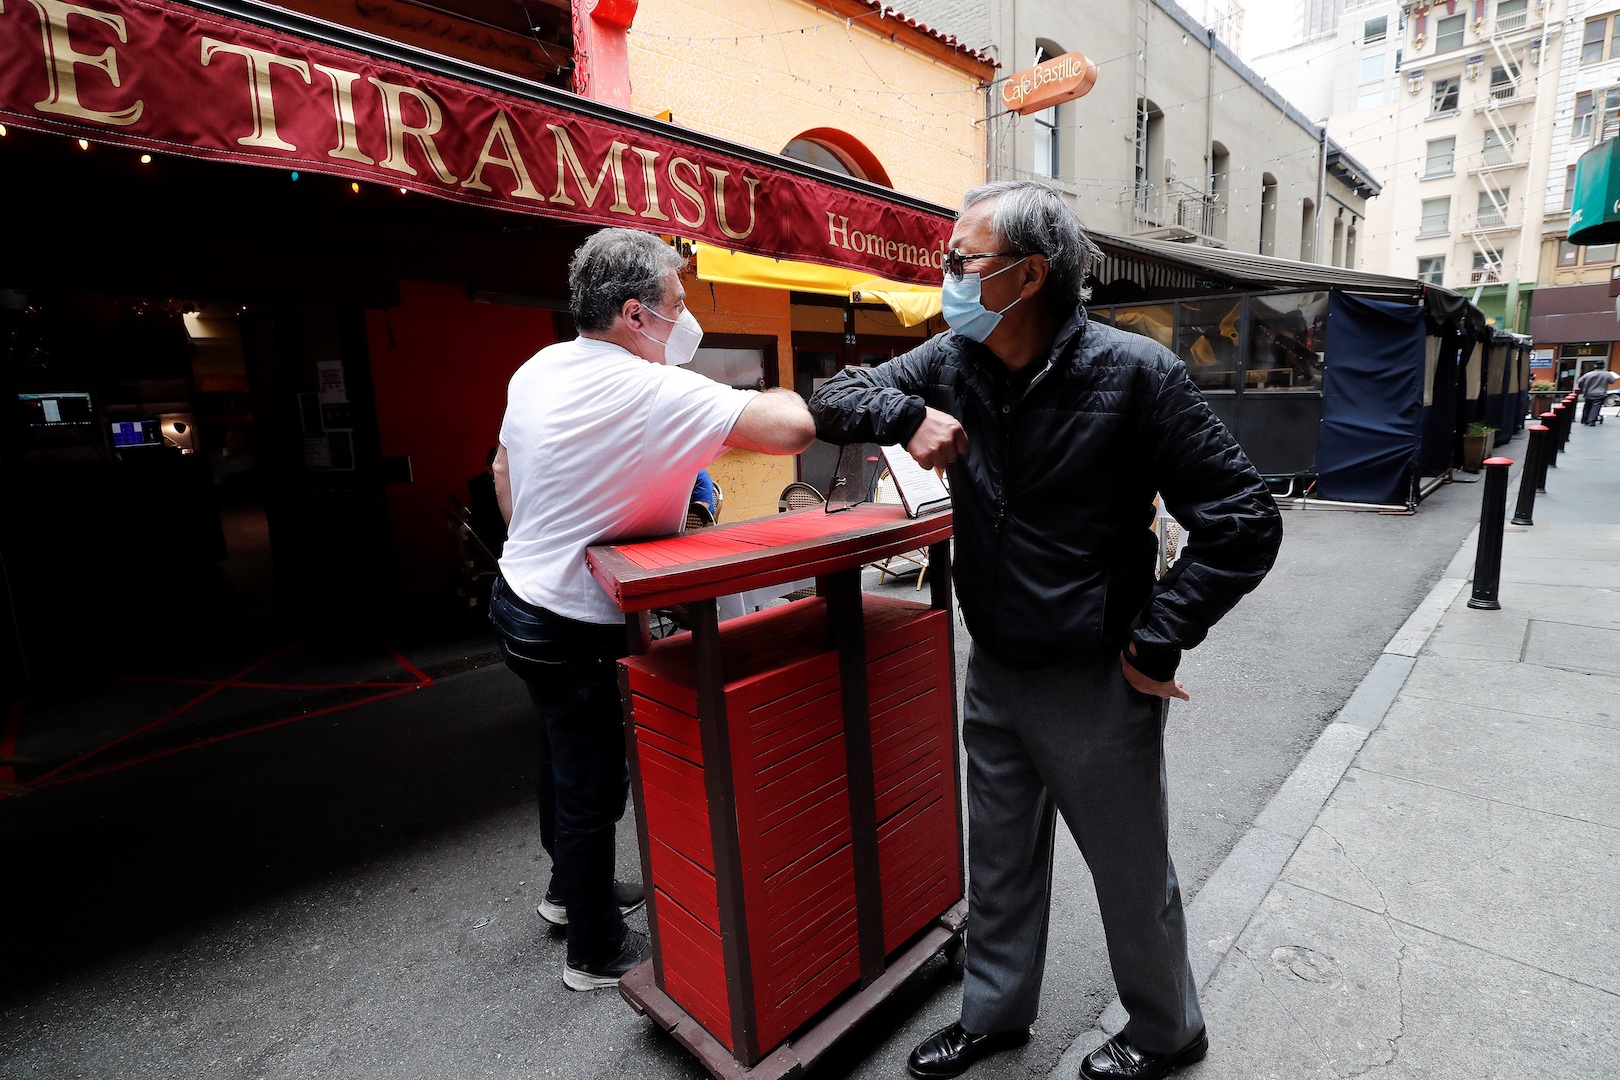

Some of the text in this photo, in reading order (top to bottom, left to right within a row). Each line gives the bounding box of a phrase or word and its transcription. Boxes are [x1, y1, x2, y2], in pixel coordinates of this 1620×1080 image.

[1033, 57, 1083, 90] Bastille
[0, 0, 760, 240] E TIRAMISU
[825, 210, 944, 270] Homemad
[845, 334, 856, 345] 22
